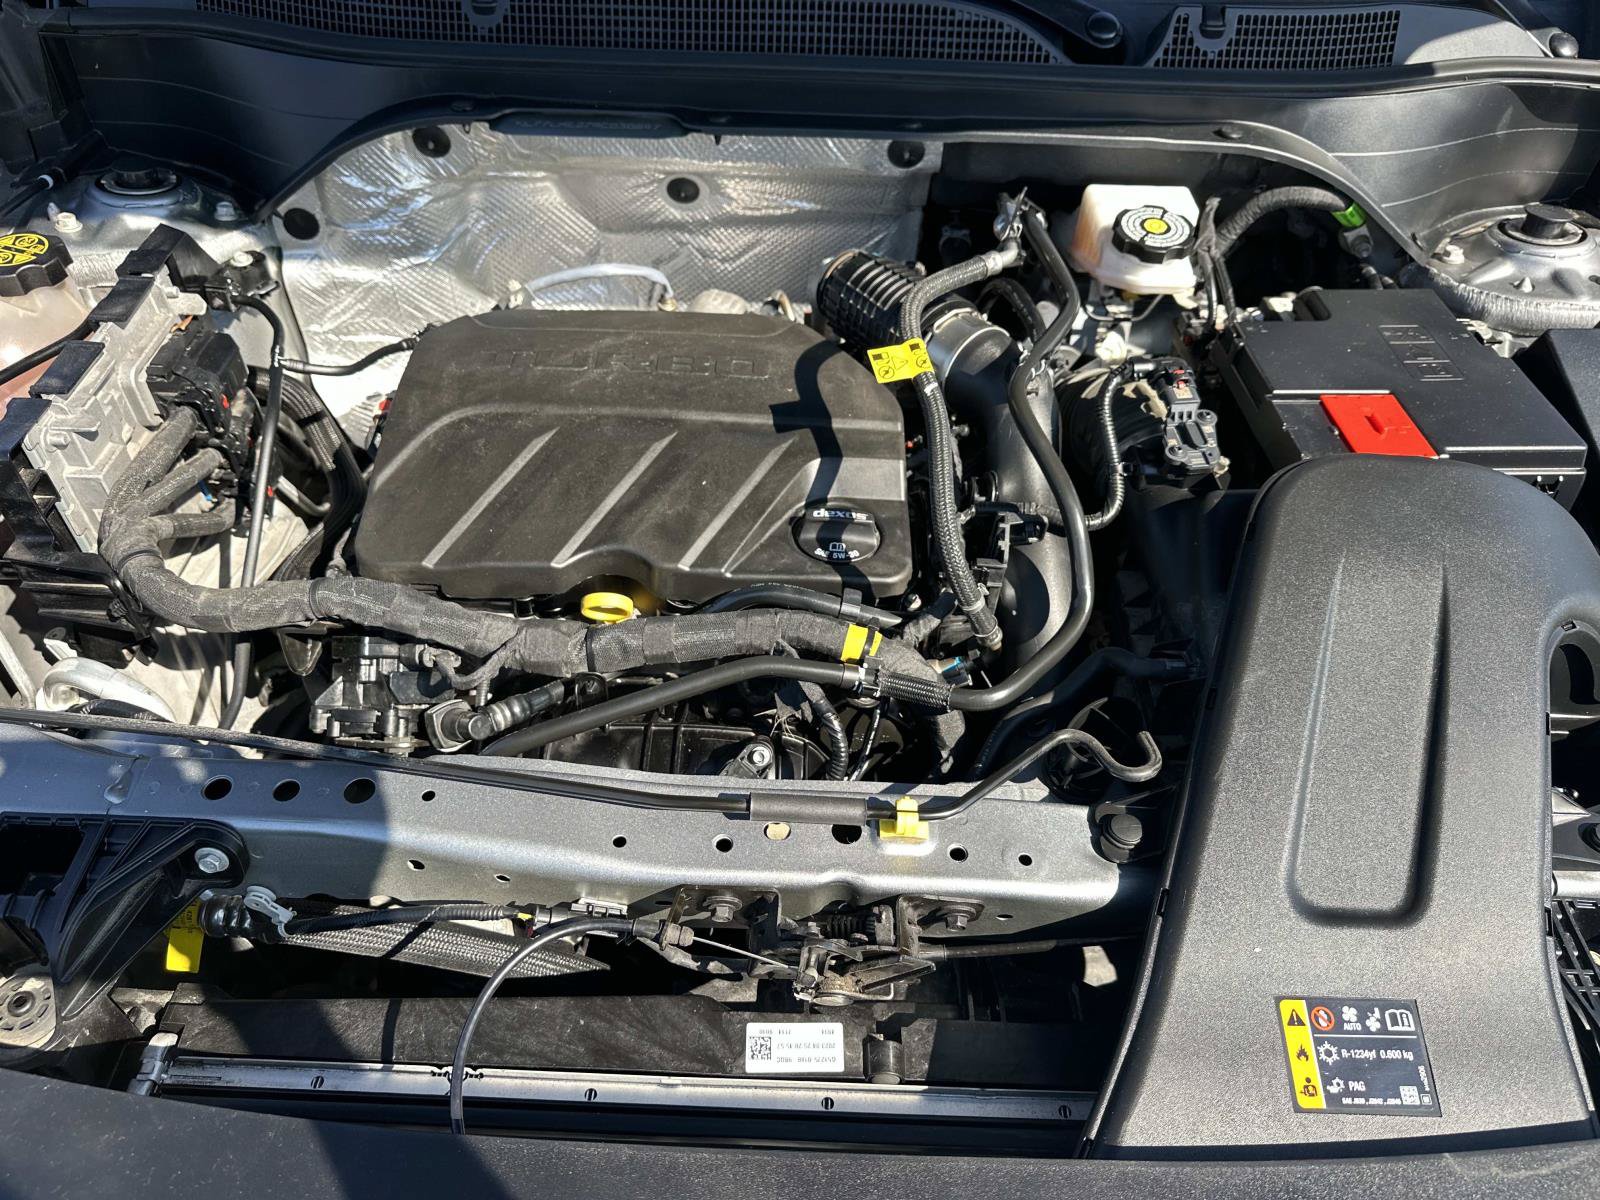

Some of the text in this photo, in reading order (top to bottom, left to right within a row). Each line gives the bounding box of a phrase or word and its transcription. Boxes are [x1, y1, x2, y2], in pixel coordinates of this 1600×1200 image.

[480, 350, 772, 380] TURBO
[813, 508, 867, 520] dexos
[833, 550, 860, 558] 5W-30
[1343, 1022, 1362, 1031] AUTO
[1341, 1049, 1414, 1060] R-1234yf 0.600 kg
[1348, 1081, 1366, 1091] PAG
